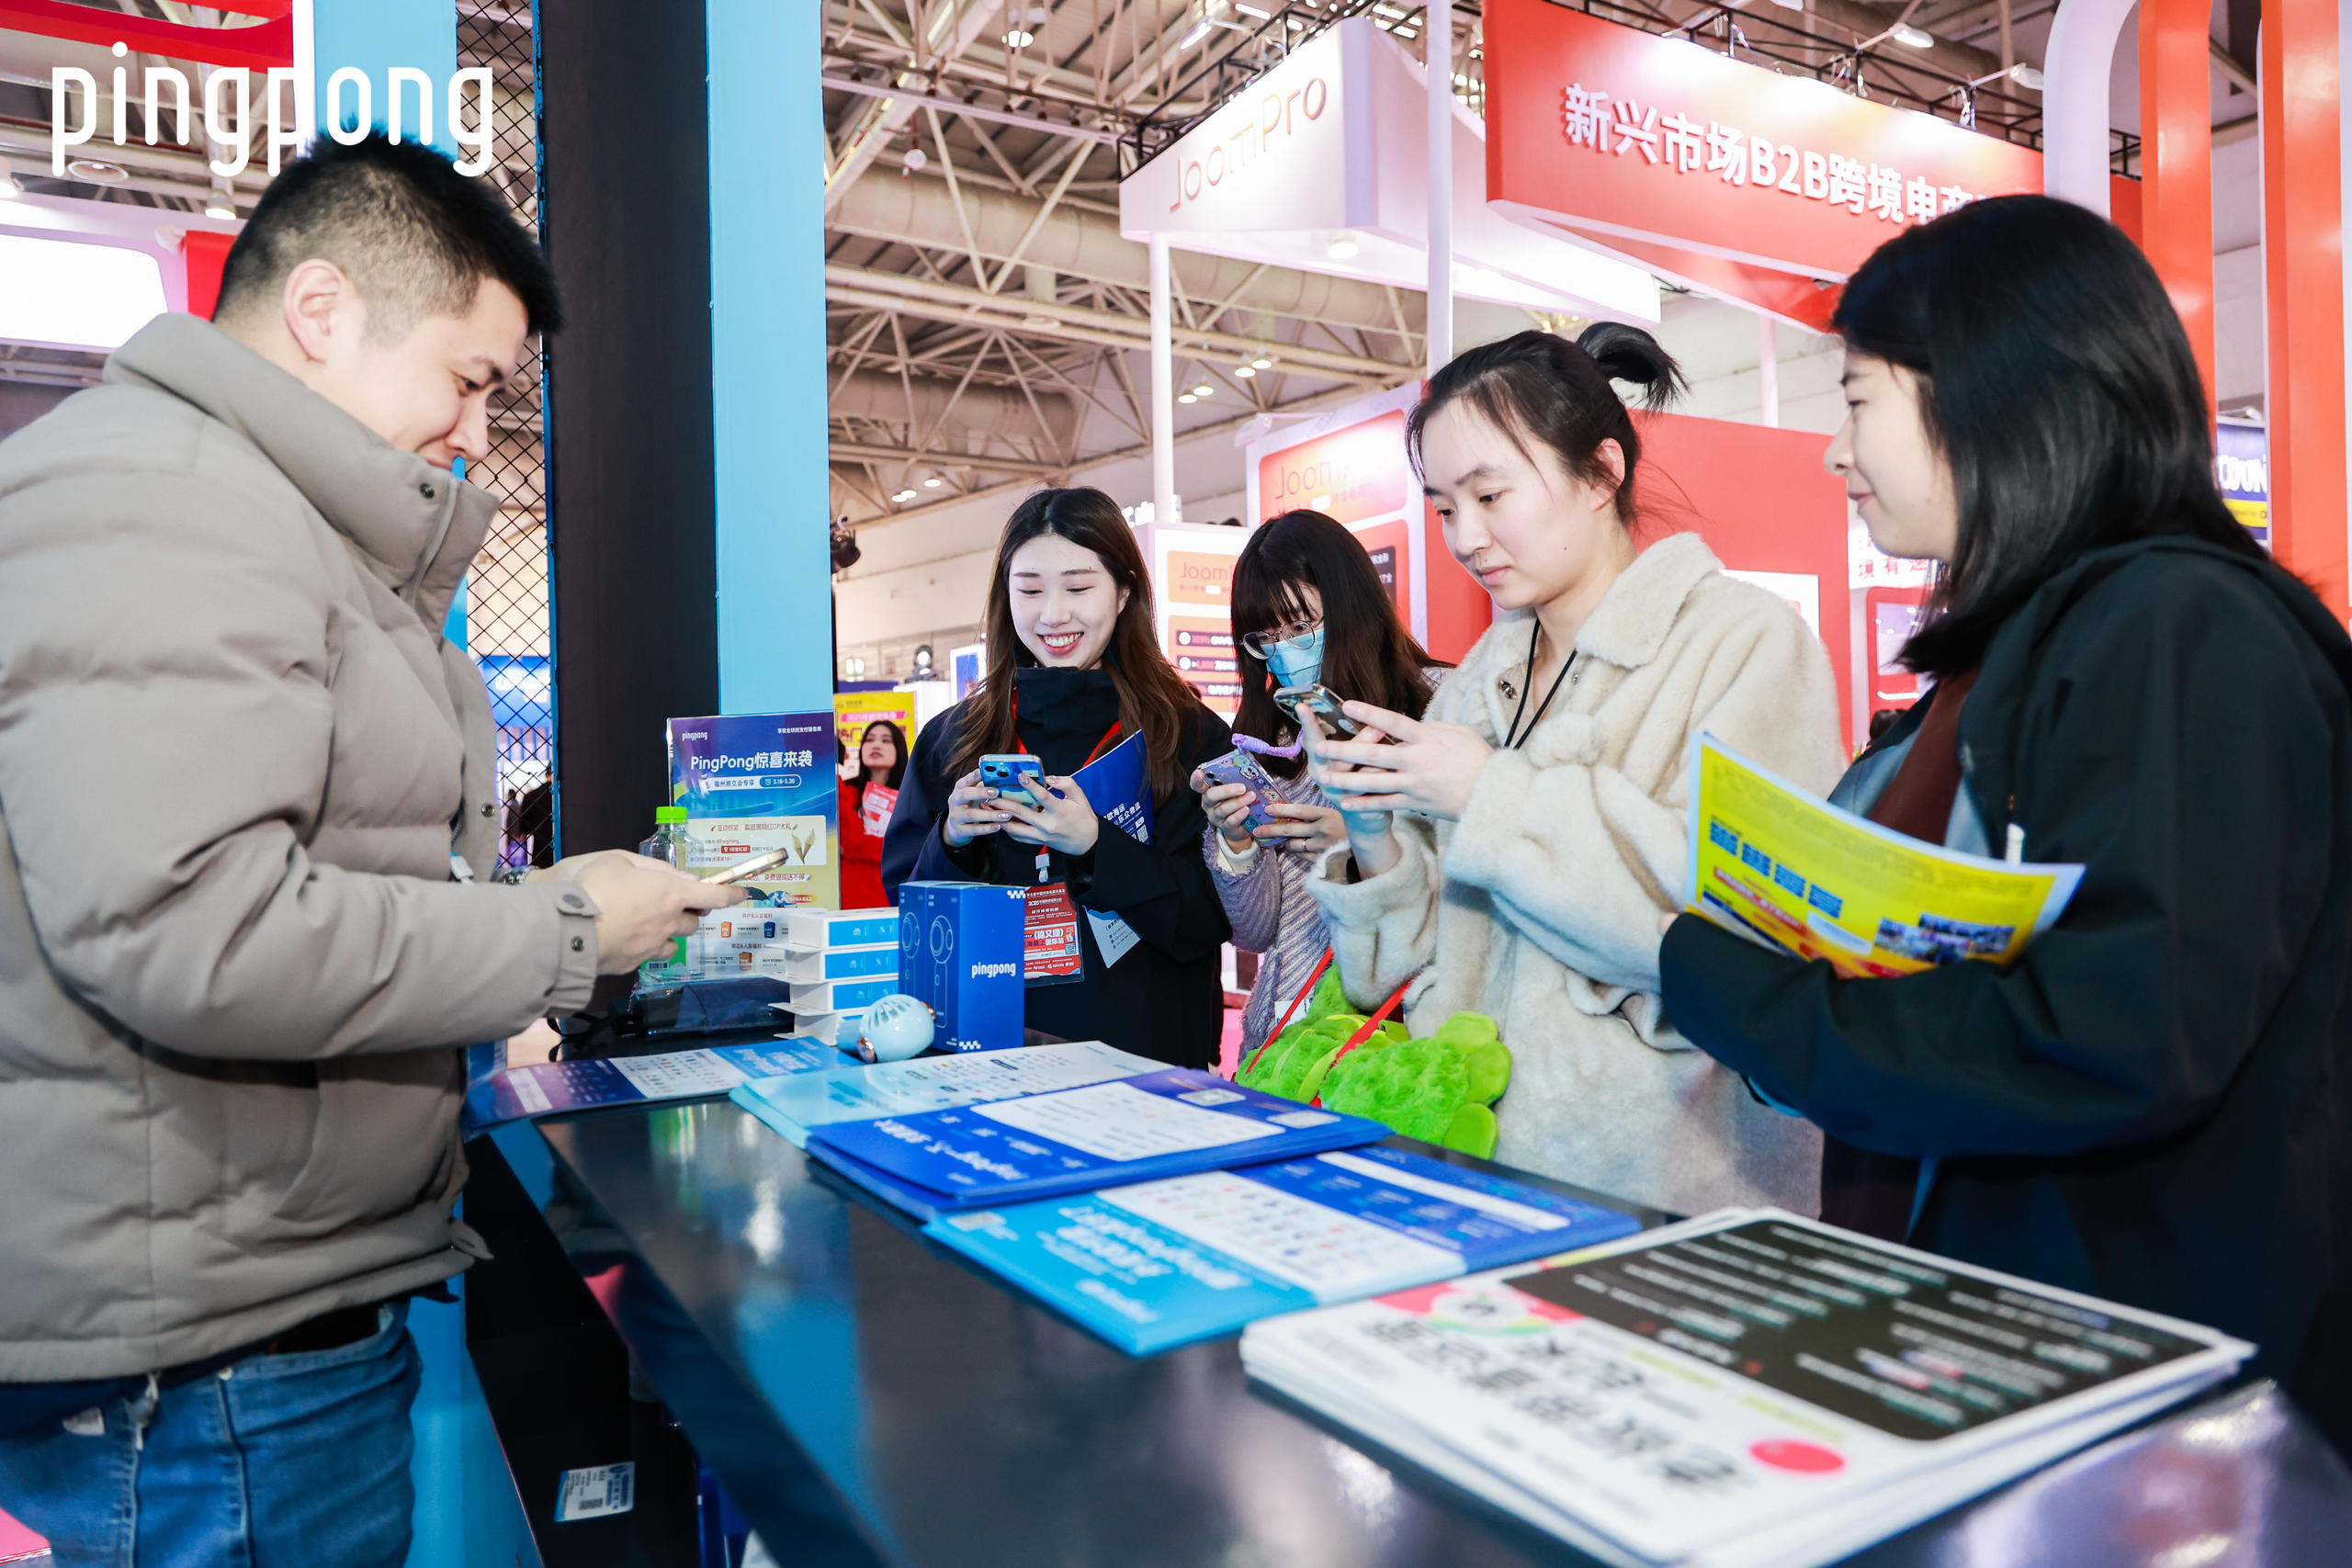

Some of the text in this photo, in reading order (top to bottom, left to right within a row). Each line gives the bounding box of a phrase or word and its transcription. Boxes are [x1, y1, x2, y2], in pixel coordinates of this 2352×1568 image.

[1565, 83, 1990, 226] 新兴市场B2B跨境电商
[682, 731, 707, 741] pingpong
[690, 749, 813, 773] PingPong惊喜来袭
[1103, 803, 1125, 820] 欧海运
[971, 962, 1017, 979] pingpong
